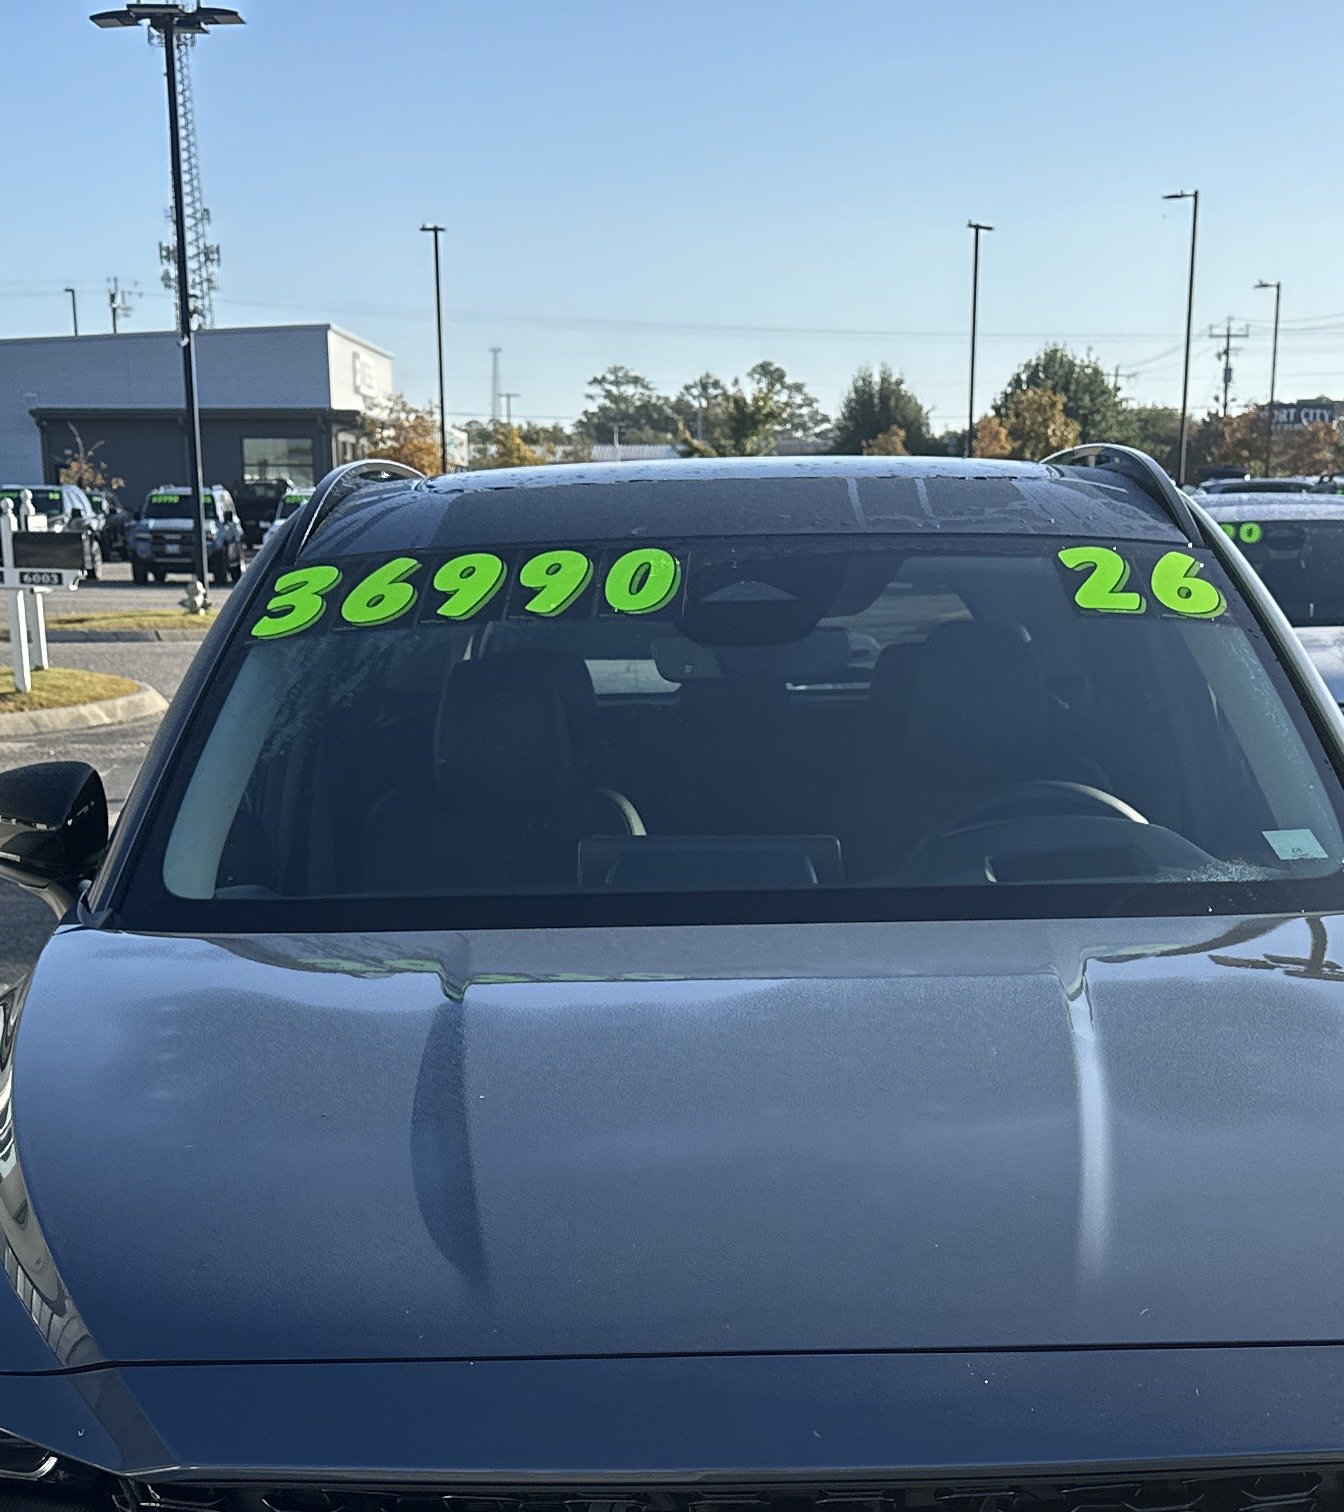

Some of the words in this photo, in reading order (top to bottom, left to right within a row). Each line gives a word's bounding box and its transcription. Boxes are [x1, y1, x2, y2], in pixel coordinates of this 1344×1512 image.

[23, 572, 59, 584] 6003
[251, 548, 681, 640] 36990
[1058, 546, 1228, 618] 26
